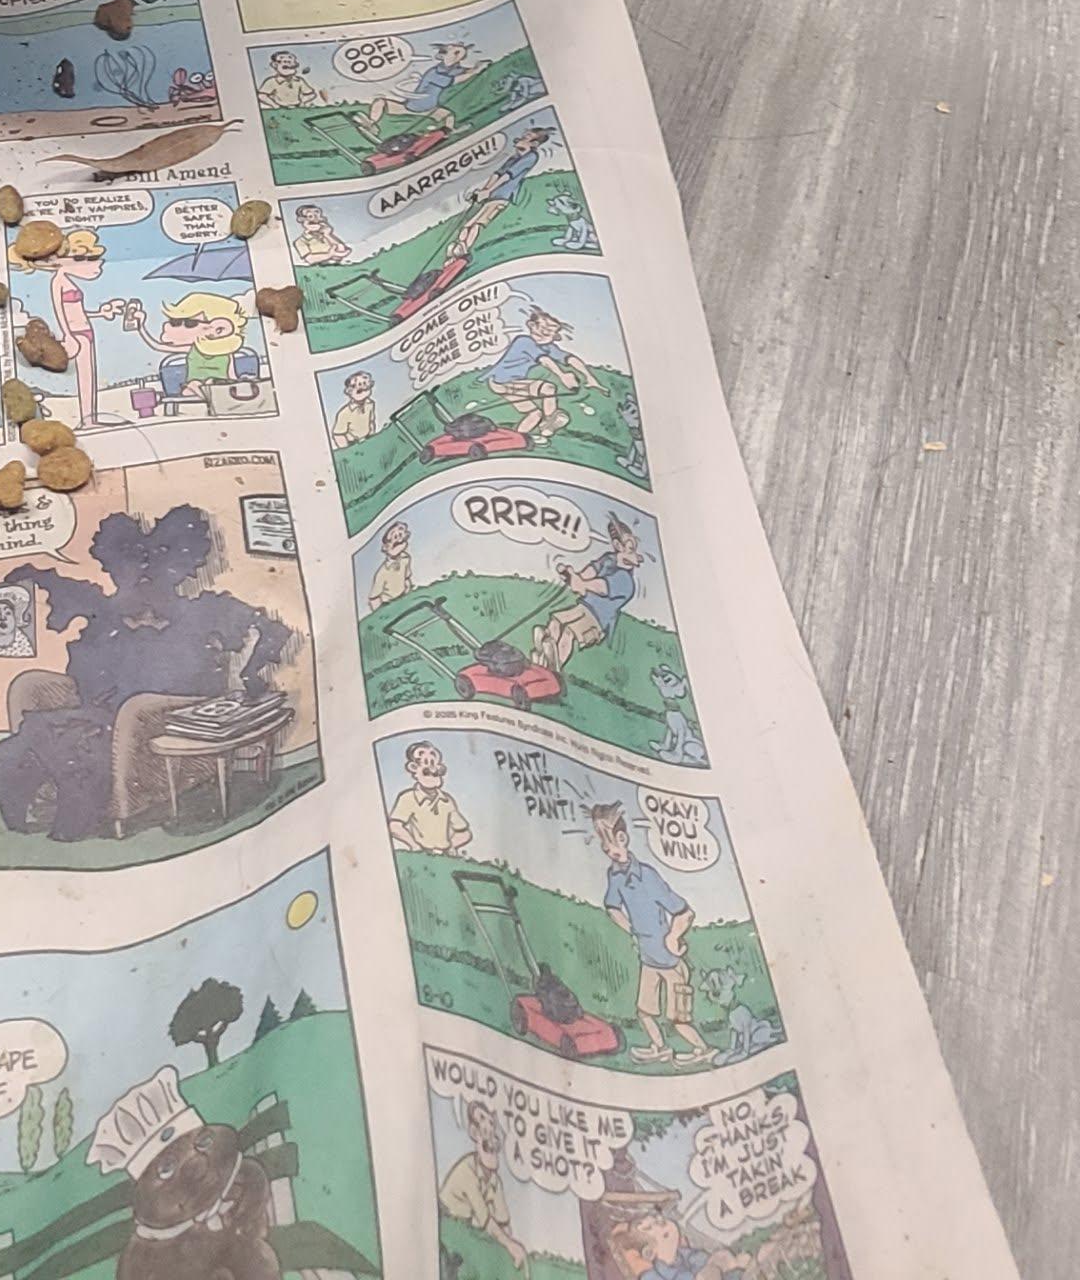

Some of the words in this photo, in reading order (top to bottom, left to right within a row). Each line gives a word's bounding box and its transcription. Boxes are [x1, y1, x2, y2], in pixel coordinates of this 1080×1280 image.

[344, 38, 395, 62] OOF!
[350, 51, 405, 75] OOF!
[166, 162, 232, 181] Amend
[378, 136, 498, 214] AAARRRGH!!
[34, 198, 59, 207] YOU
[63, 196, 80, 207] DO
[83, 195, 131, 205] REALIZE
[58, 203, 83, 215] NOT
[174, 204, 218, 214] BETTER
[64, 214, 104, 224] RIGHT?
[182, 213, 214, 222] SAFE
[184, 222, 215, 230] THAN
[400, 311, 449, 353] COME
[458, 286, 499, 312] ON!!
[415, 328, 457, 362] COME
[462, 312, 492, 331] ON!
[417, 339, 460, 372] COME
[465, 324, 494, 342] ON!
[420, 348, 462, 382] COME
[468, 335, 498, 353] ON!
[36, 495, 52, 511] &
[5, 516, 55, 533] thing
[465, 496, 582, 539] RRRR!!
[458, 710, 480, 721] King
[480, 711, 516, 727] Features
[518, 719, 555, 739] Syndicate
[493, 750, 547, 773] PANT!
[510, 772, 561, 798] PANT!
[525, 796, 576, 822] PANT!
[644, 795, 699, 822] OKAY!
[656, 816, 698, 839] YOU
[661, 838, 709, 861] WIN!!
[431, 1057, 499, 1099] WOULD
[503, 1083, 541, 1119] YOU
[547, 1102, 589, 1134] LIKE
[597, 1115, 628, 1139] ME
[721, 1100, 757, 1124] NO,
[503, 1109, 527, 1137] TO
[534, 1122, 576, 1154] GIVE
[581, 1135, 604, 1160] IT
[512, 1142, 524, 1161] A
[531, 1149, 597, 1184] SHOT?
[702, 1152, 730, 1180] I'M
[737, 1126, 790, 1163] JUST
[727, 1149, 786, 1191] TAKIN'
[720, 1200, 731, 1218] A
[738, 1166, 808, 1210] BREAK
